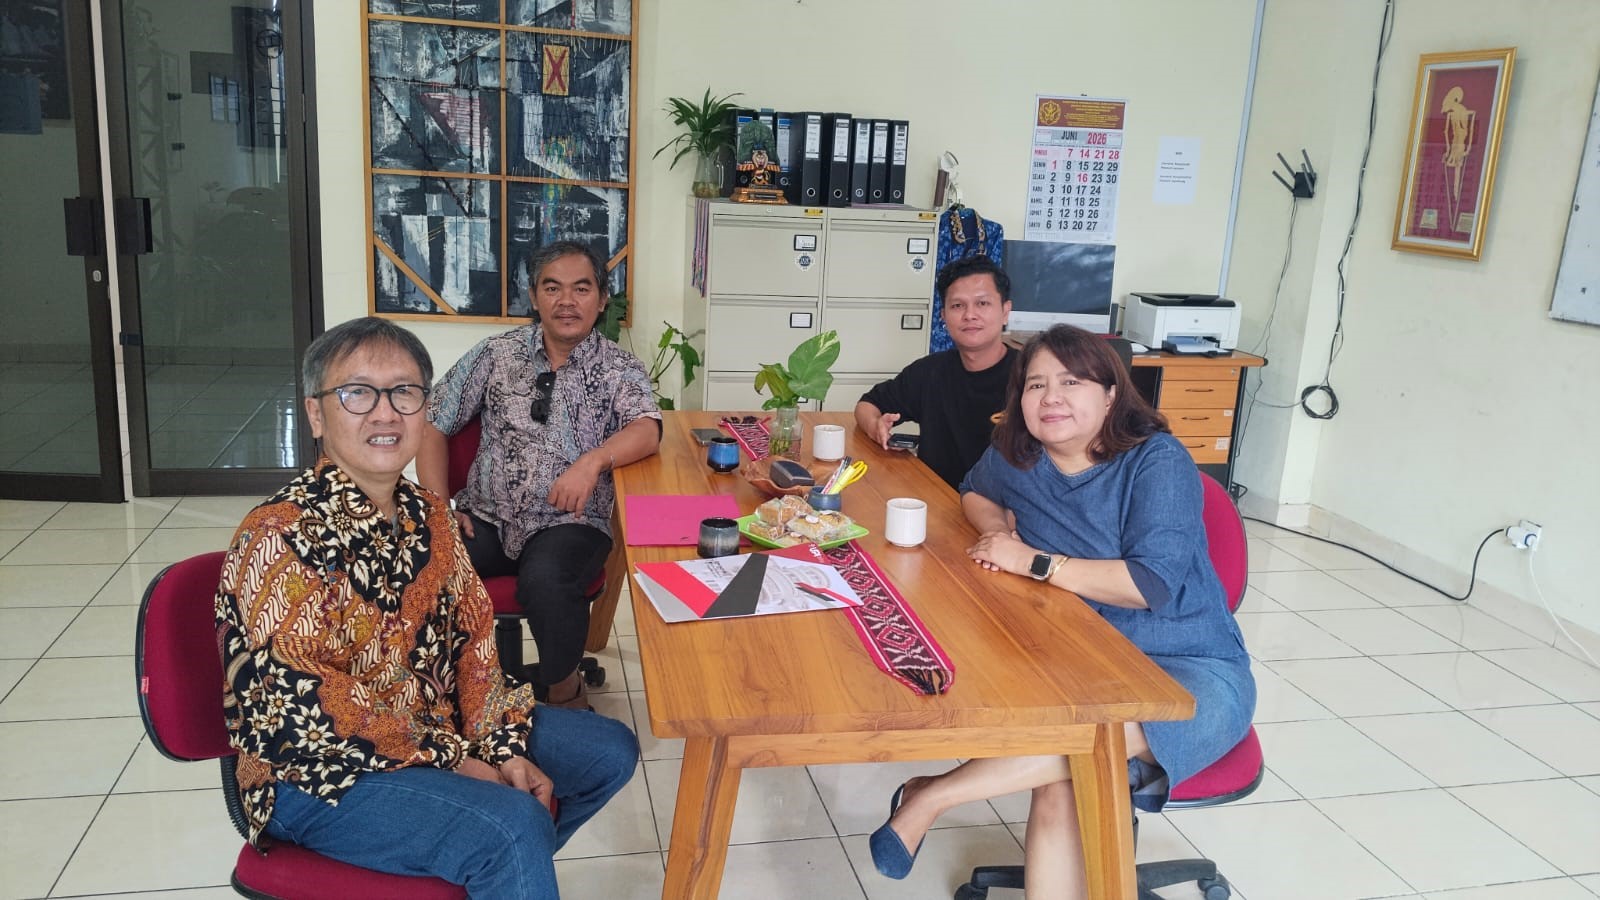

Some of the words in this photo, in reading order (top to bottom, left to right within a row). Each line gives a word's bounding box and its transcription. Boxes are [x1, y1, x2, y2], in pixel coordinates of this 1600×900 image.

[1061, 131, 1078, 140] JUNI
[1087, 132, 1107, 145] 2026
[1068, 148, 1074, 157] 7
[1080, 150, 1090, 158] 14
[1094, 150, 1104, 159] 21
[1108, 150, 1120, 160] 28
[1052, 160, 1056, 170] 1
[1066, 161, 1072, 170] 8
[1078, 162, 1088, 170] 15
[1093, 162, 1104, 171] 22
[1107, 162, 1118, 172] 29
[1050, 172, 1056, 182] 2
[1065, 172, 1070, 182] 9
[1078, 174, 1088, 182] 16
[1092, 174, 1102, 183] 23
[1106, 174, 1117, 184] 30
[1050, 184, 1055, 194] 3
[1062, 185, 1072, 194] 10
[1076, 186, 1086, 194] 17
[1090, 186, 1101, 195] 24
[1048, 196, 1054, 205] 4
[1061, 197, 1070, 206] 11
[1074, 198, 1085, 206] 18
[1089, 198, 1100, 207] 25
[1048, 208, 1052, 217] 5
[1060, 209, 1070, 218] 12
[1074, 210, 1084, 218] 19
[1088, 210, 1098, 218] 26
[1046, 220, 1052, 229] 6
[1058, 220, 1068, 230] 13
[1072, 221, 1082, 230] 20
[1086, 222, 1098, 230] 27
